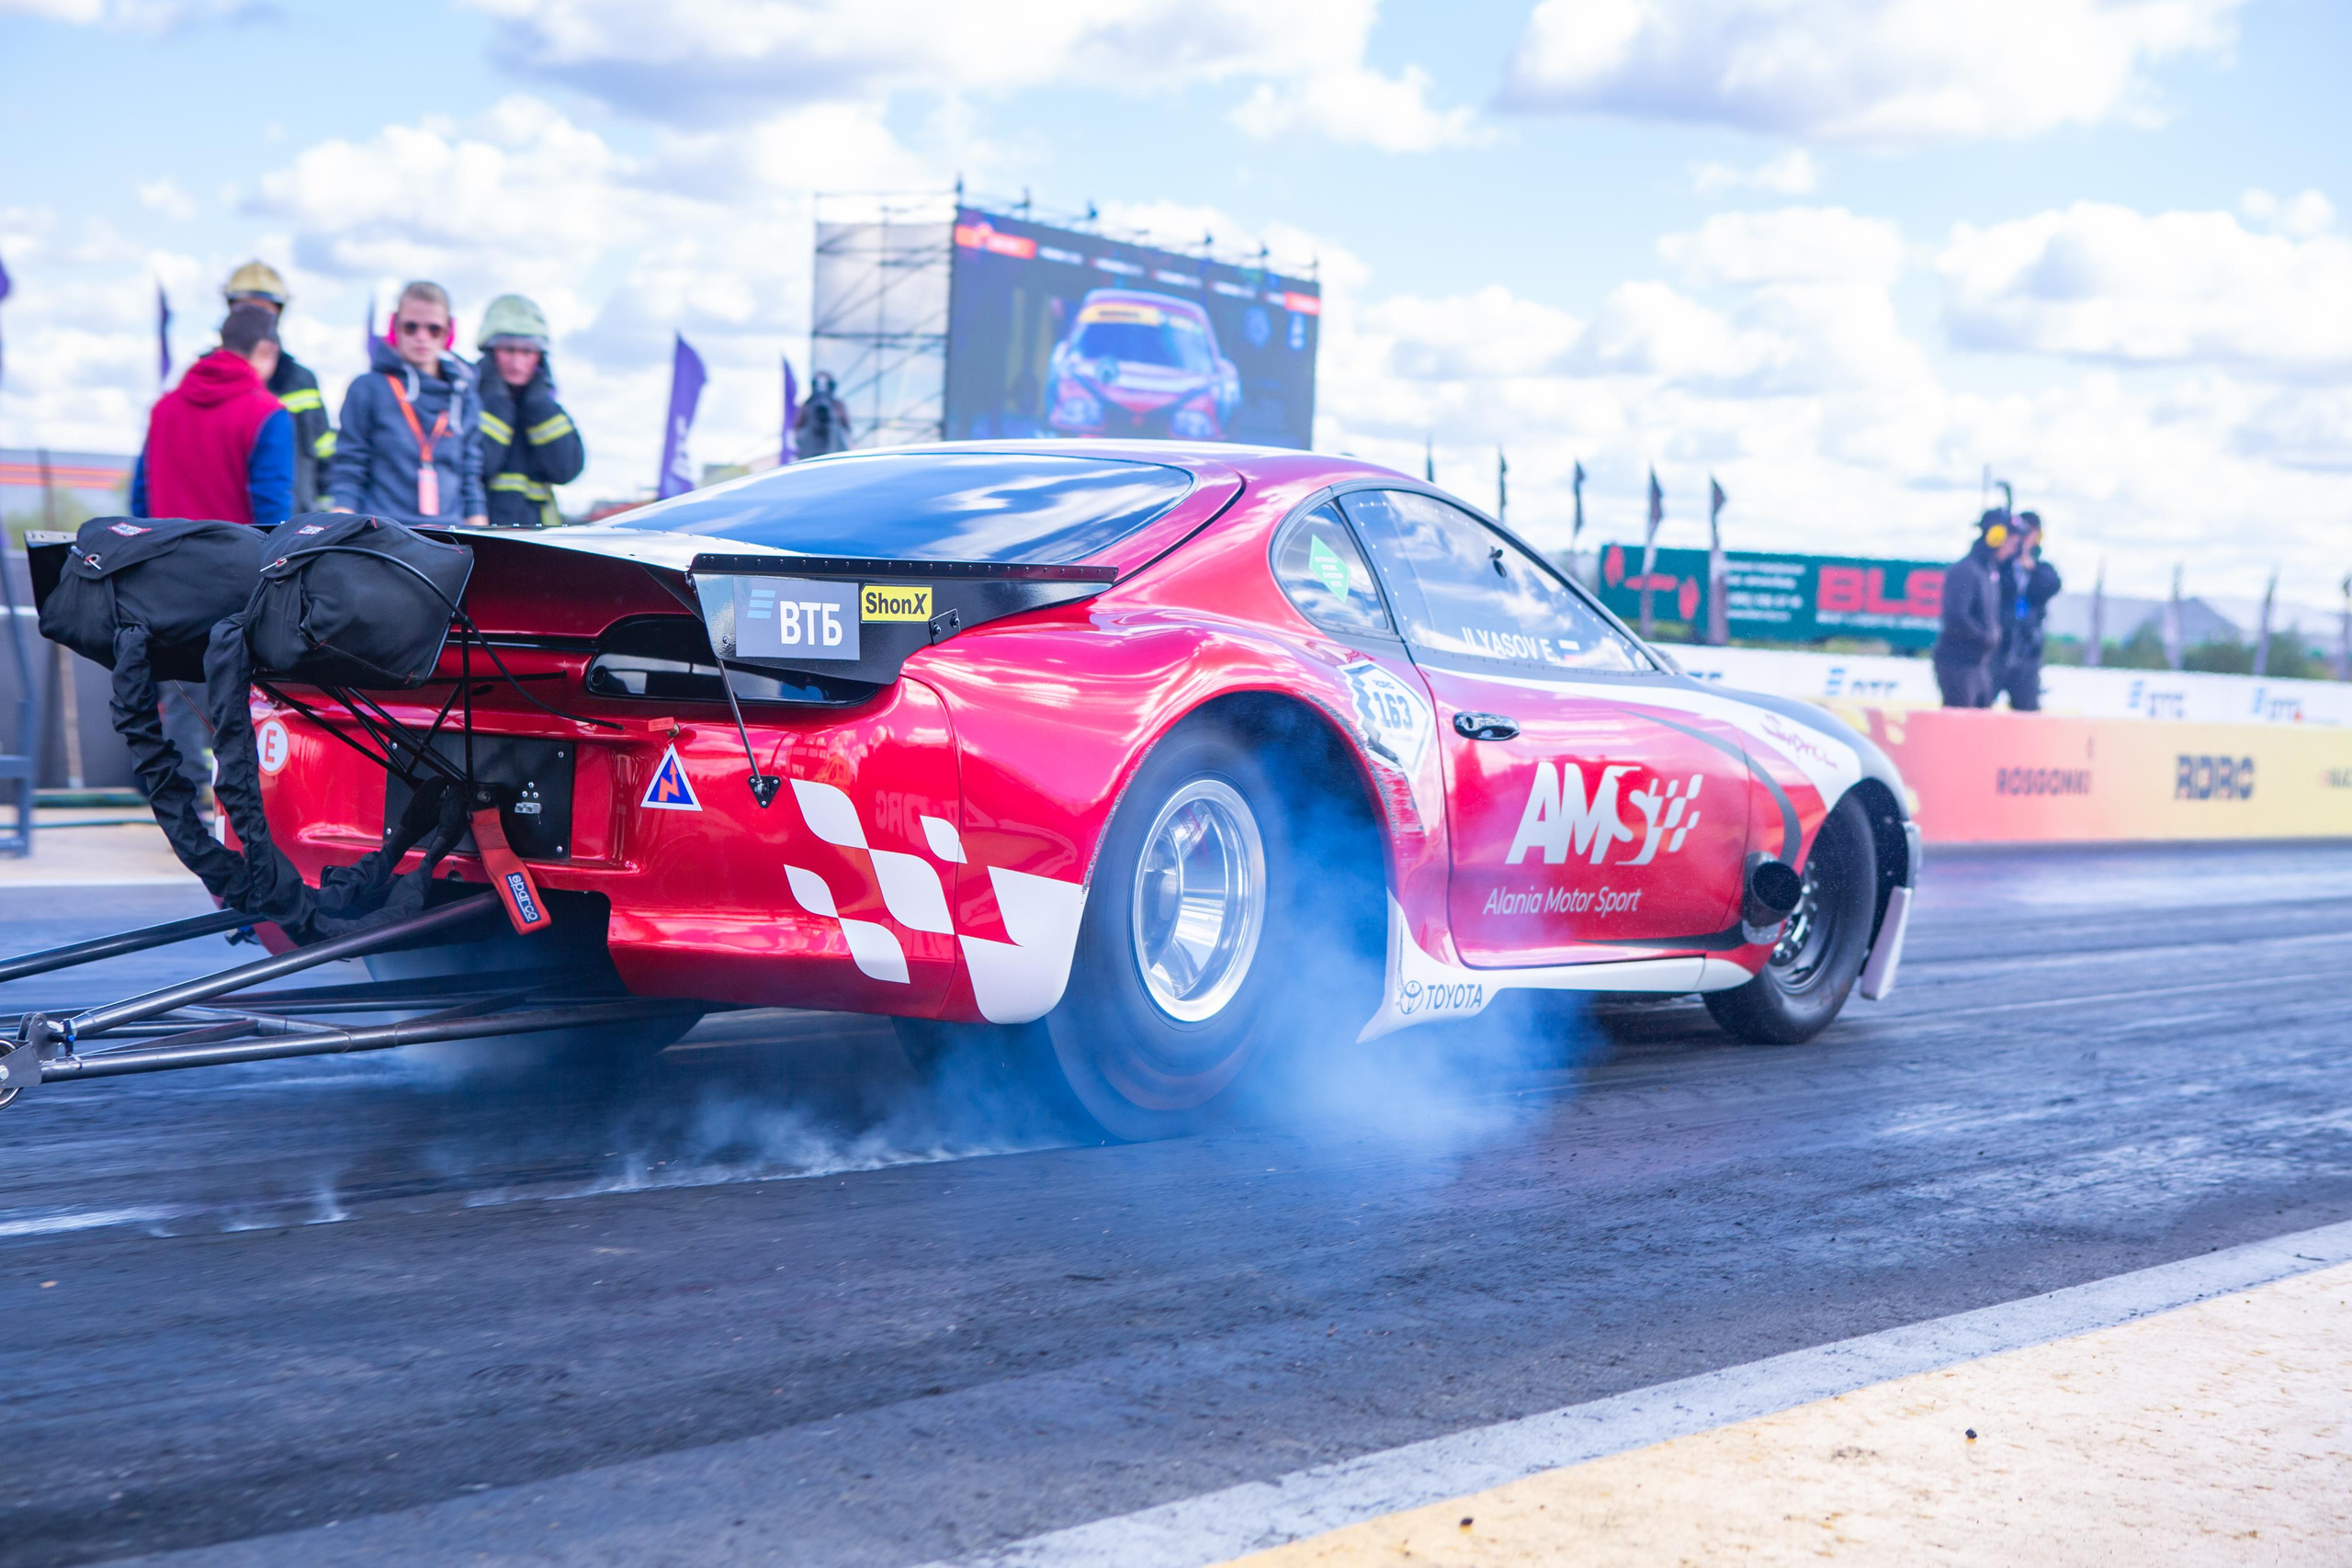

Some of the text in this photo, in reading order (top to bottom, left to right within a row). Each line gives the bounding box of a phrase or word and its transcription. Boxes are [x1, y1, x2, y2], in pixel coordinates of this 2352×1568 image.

[865, 592, 927, 615] ShonX
[780, 601, 842, 646] ВТБ
[1374, 692, 1413, 729] 163
[265, 729, 277, 762] E
[1483, 886, 1641, 918] Alania Motor Sport
[1426, 984, 1482, 1010] TOYOTA
